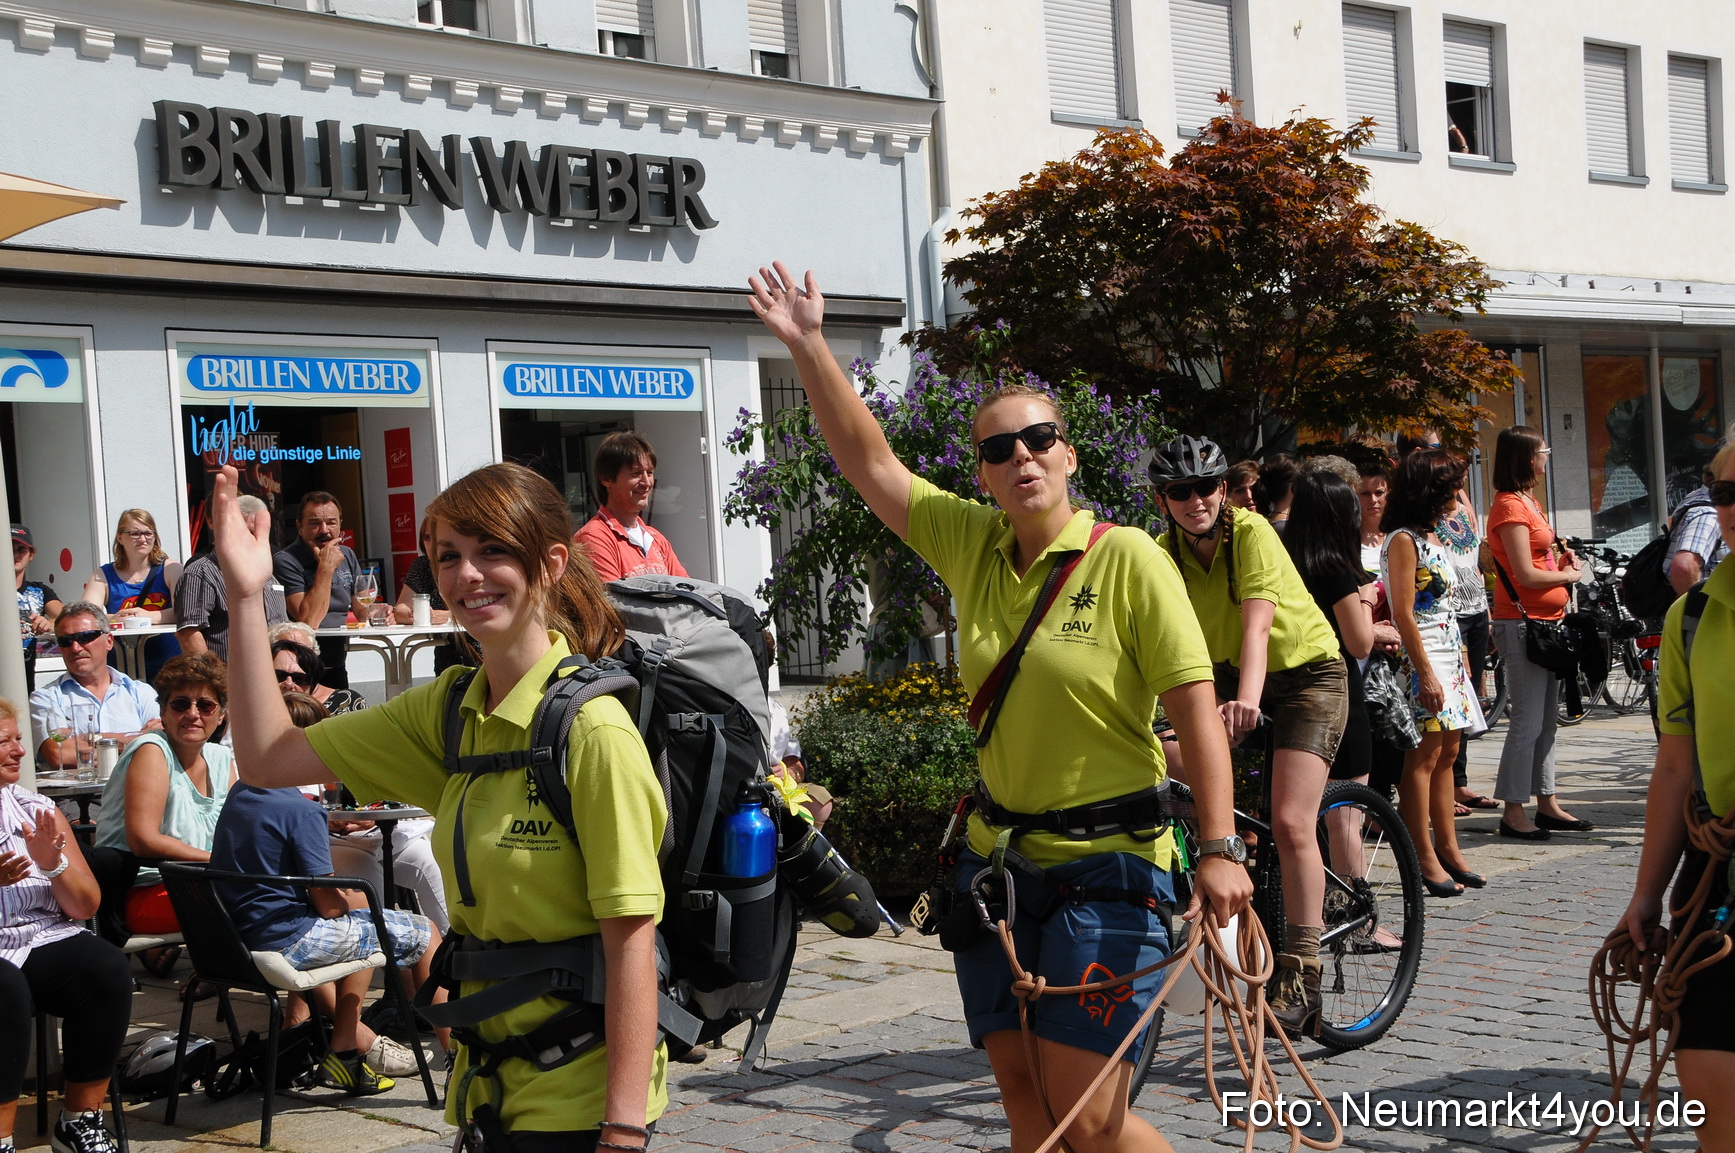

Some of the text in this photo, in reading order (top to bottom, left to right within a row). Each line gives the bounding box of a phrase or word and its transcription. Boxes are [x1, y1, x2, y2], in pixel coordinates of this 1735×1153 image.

[153, 99, 719, 230] BRILLEN WEBER
[202, 358, 412, 391] BRILLEN WEBER
[515, 366, 687, 396] BRILLEN WEBER
[190, 397, 260, 466] light
[249, 434, 278, 452] HIDE
[233, 446, 256, 461] die
[260, 446, 323, 464] günstige
[326, 446, 361, 460] Linie
[1061, 620, 1093, 633] DAV
[510, 819, 554, 836] DAV
[501, 835, 526, 843] Deutscher
